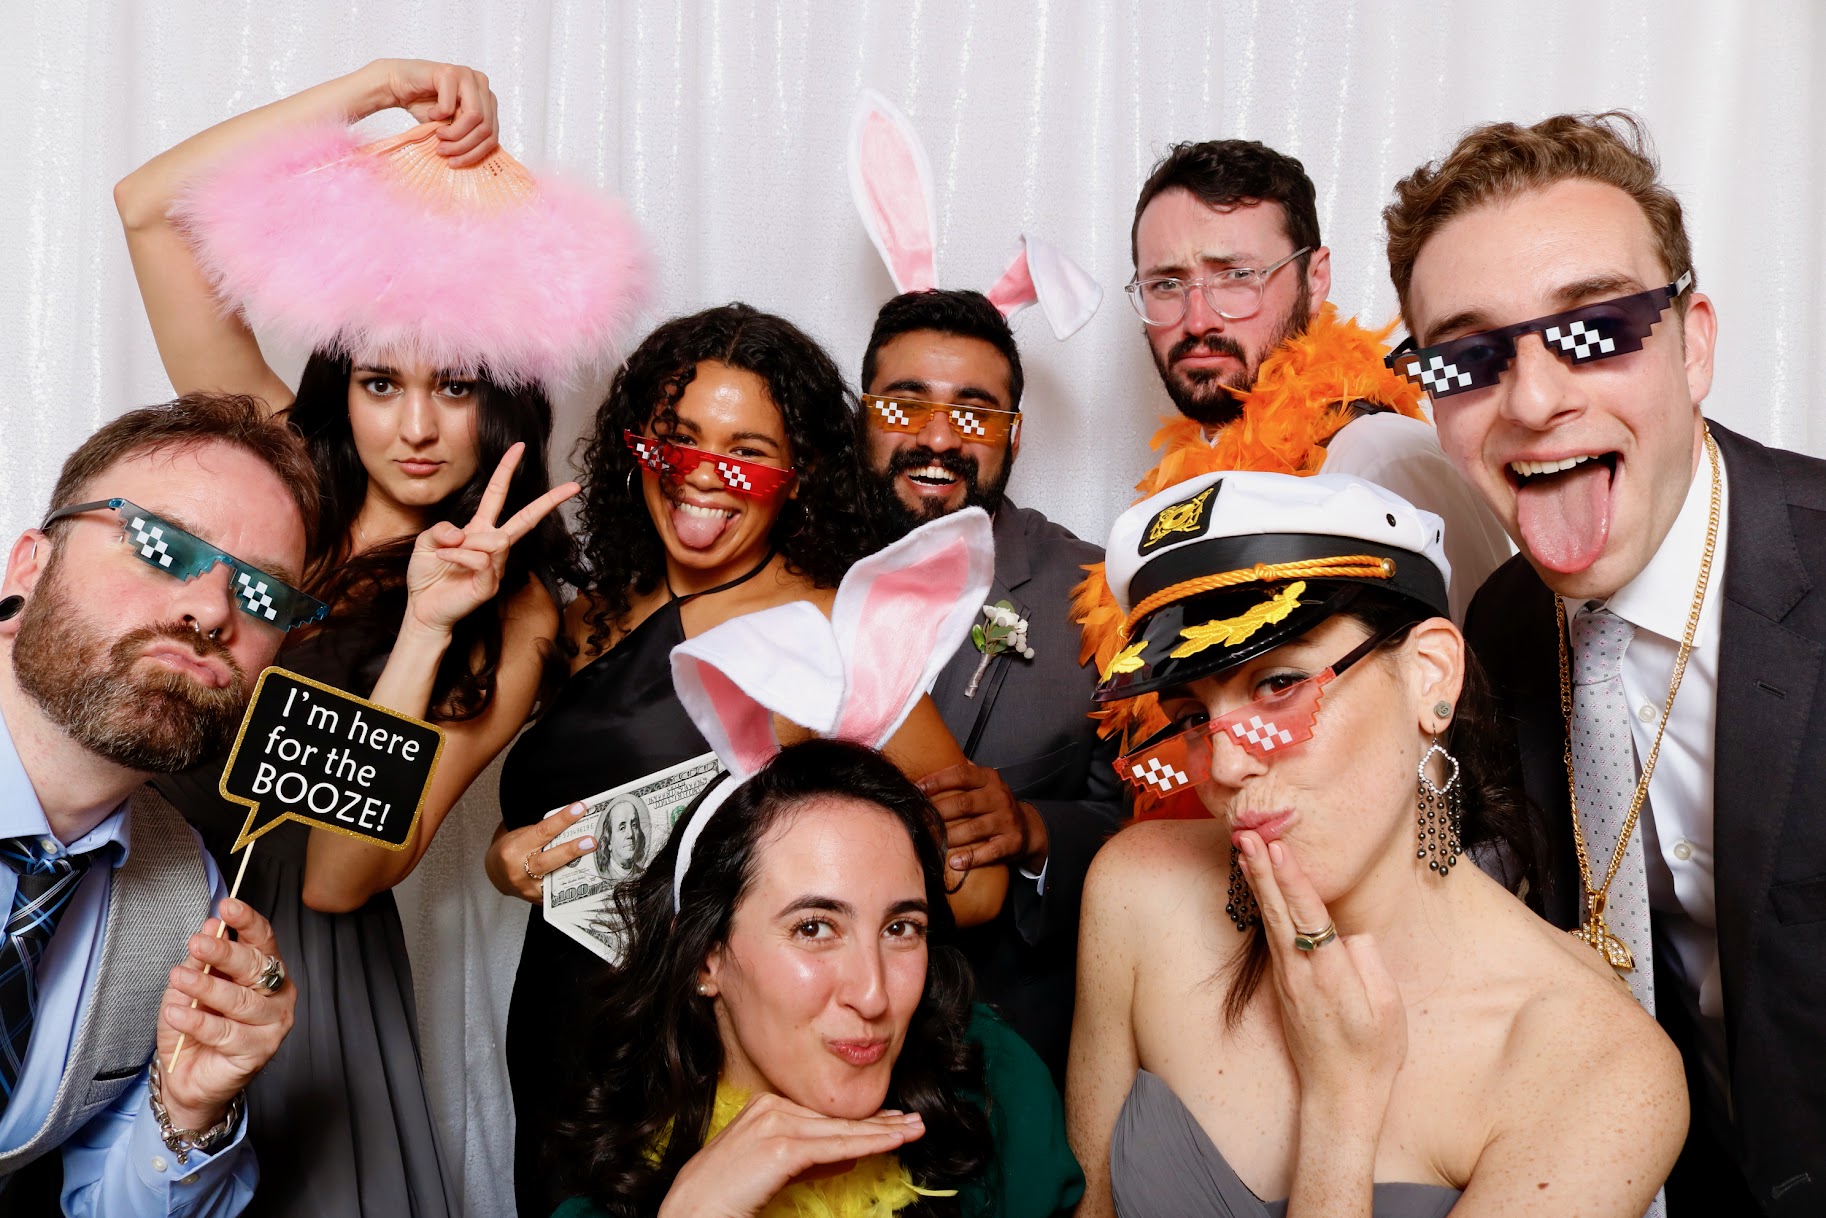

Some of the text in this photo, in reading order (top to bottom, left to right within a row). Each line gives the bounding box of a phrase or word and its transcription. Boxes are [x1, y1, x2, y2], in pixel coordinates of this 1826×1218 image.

[264, 725, 377, 787] for the
[347, 711, 420, 762] here
[251, 762, 391, 832] BOOZE!
[557, 883, 589, 903] 100
